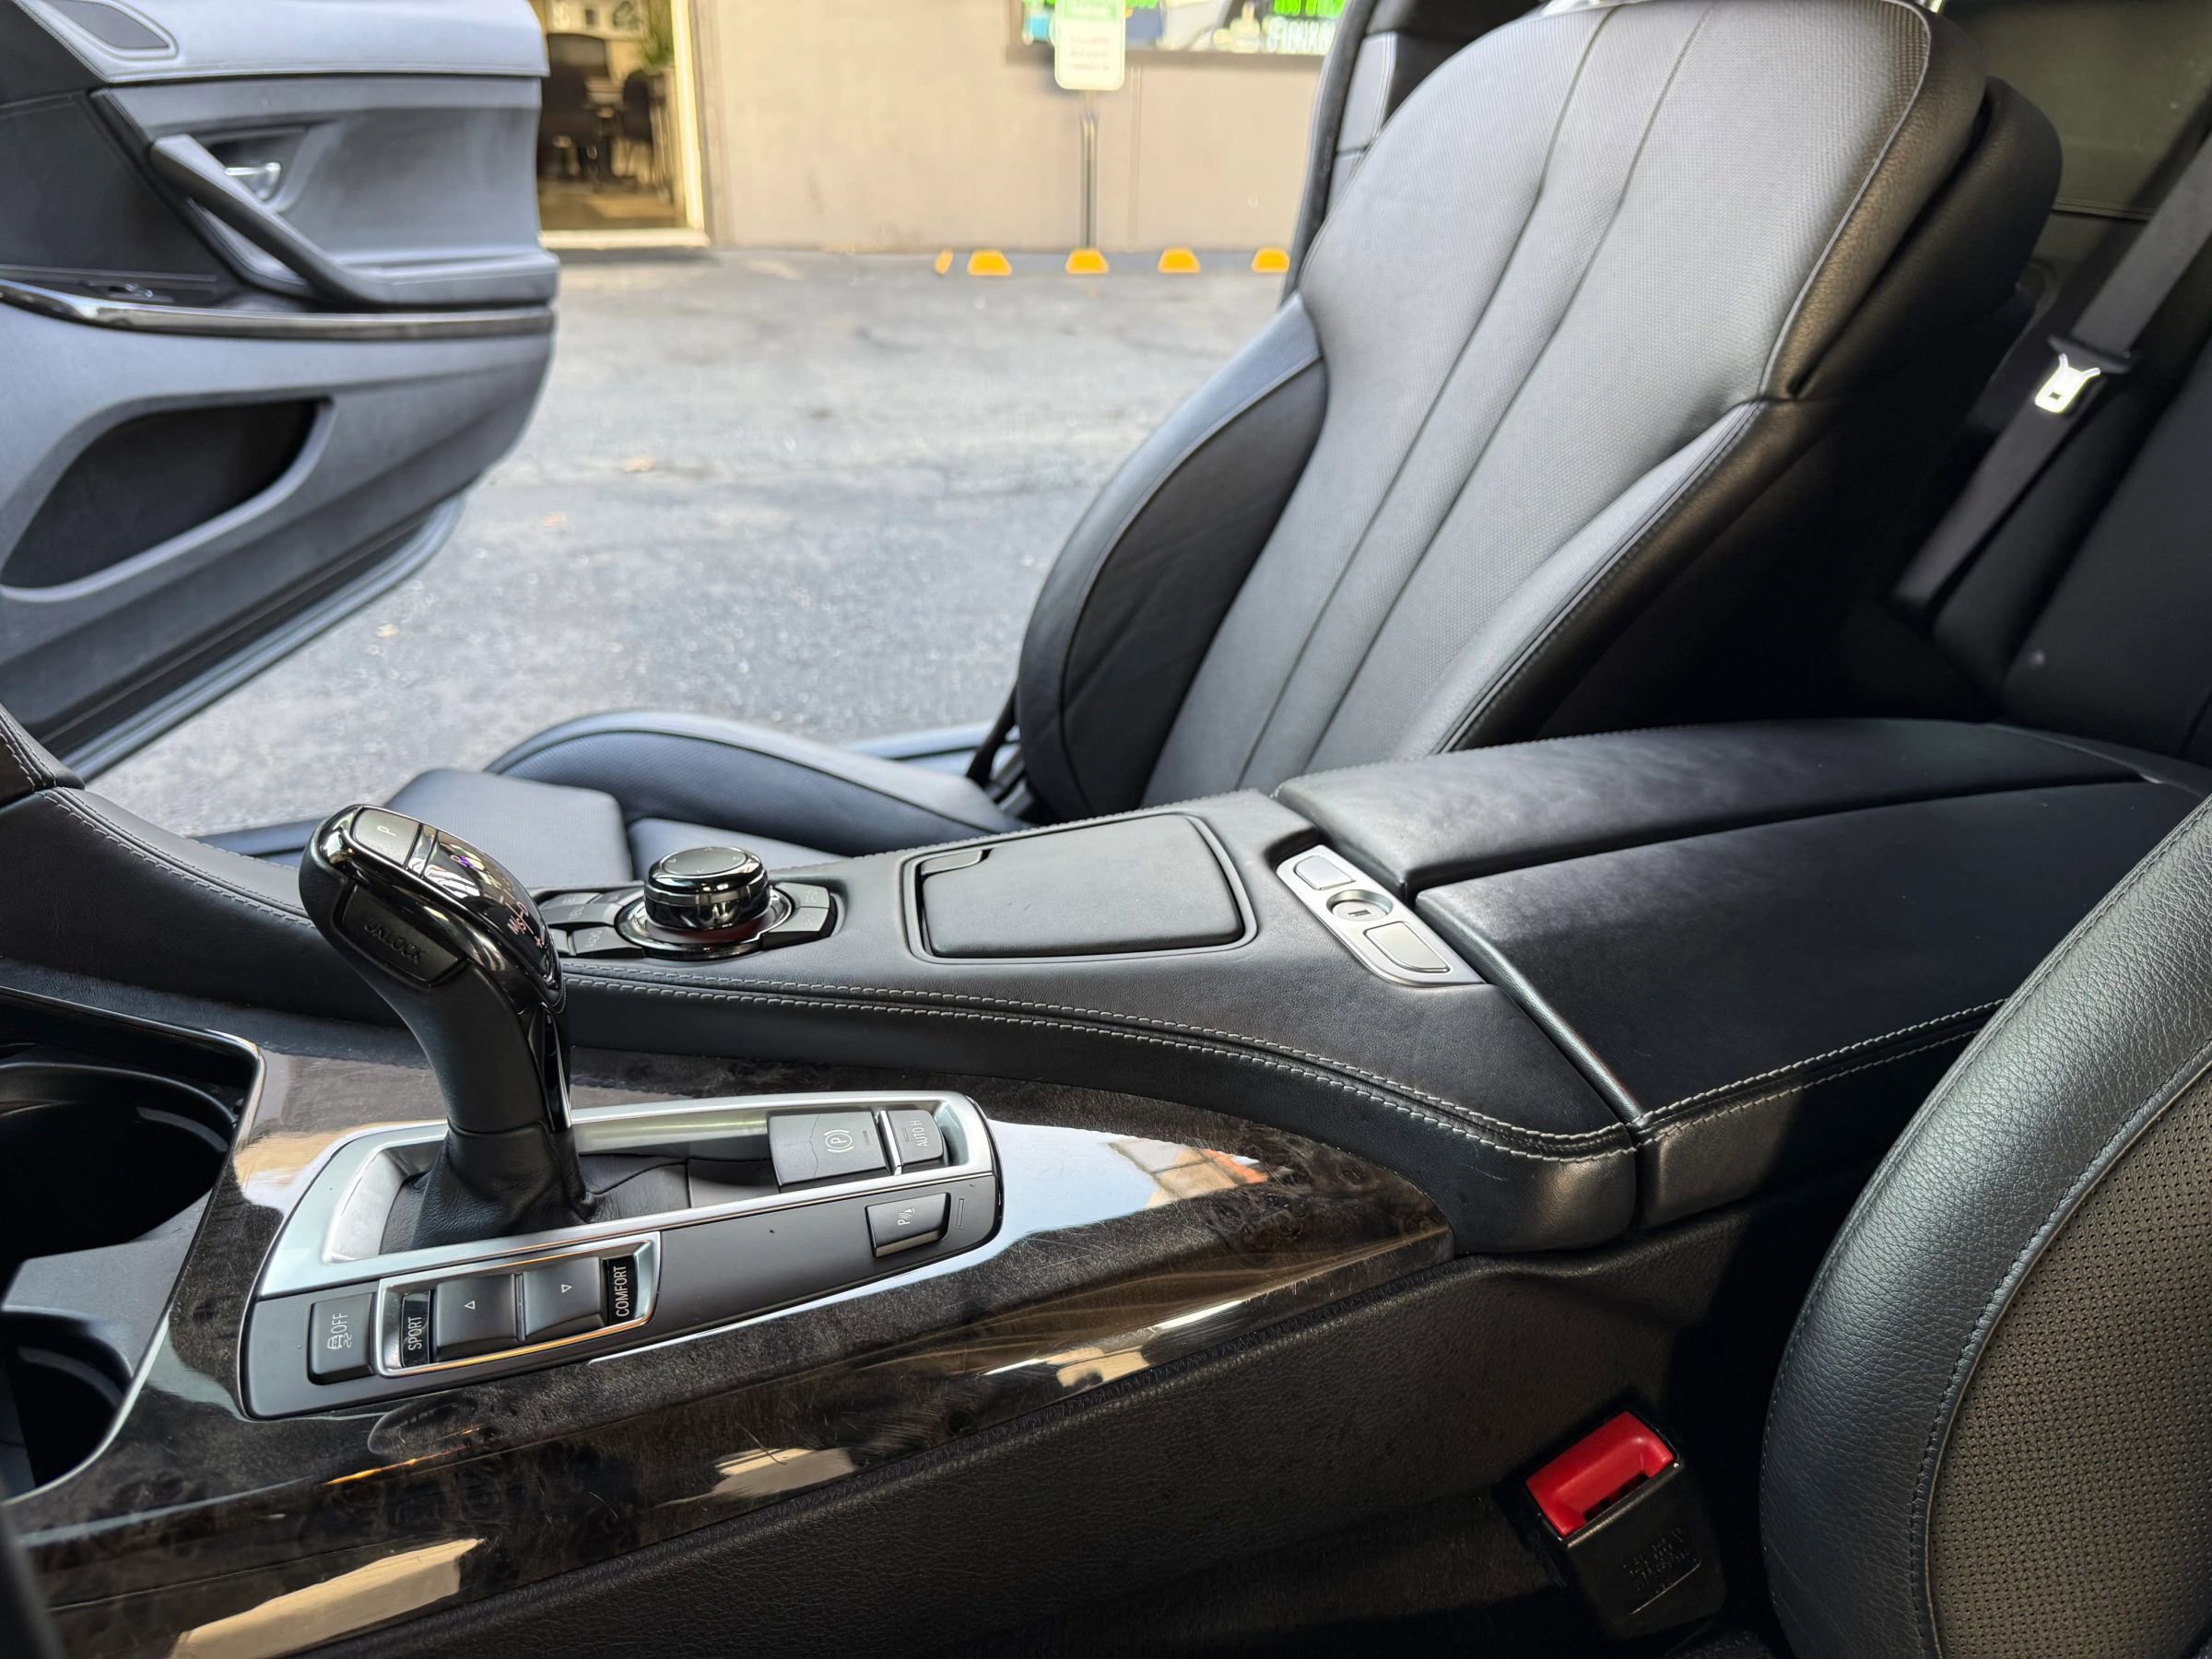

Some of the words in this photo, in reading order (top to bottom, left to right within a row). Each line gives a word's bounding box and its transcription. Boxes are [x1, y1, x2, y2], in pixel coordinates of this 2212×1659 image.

[377, 826, 397, 837] P
[912, 1127, 929, 1147] AUTO
[613, 1265, 629, 1317] COMFORT
[330, 1312, 349, 1334] OFF
[407, 1316, 423, 1351] SPORT
